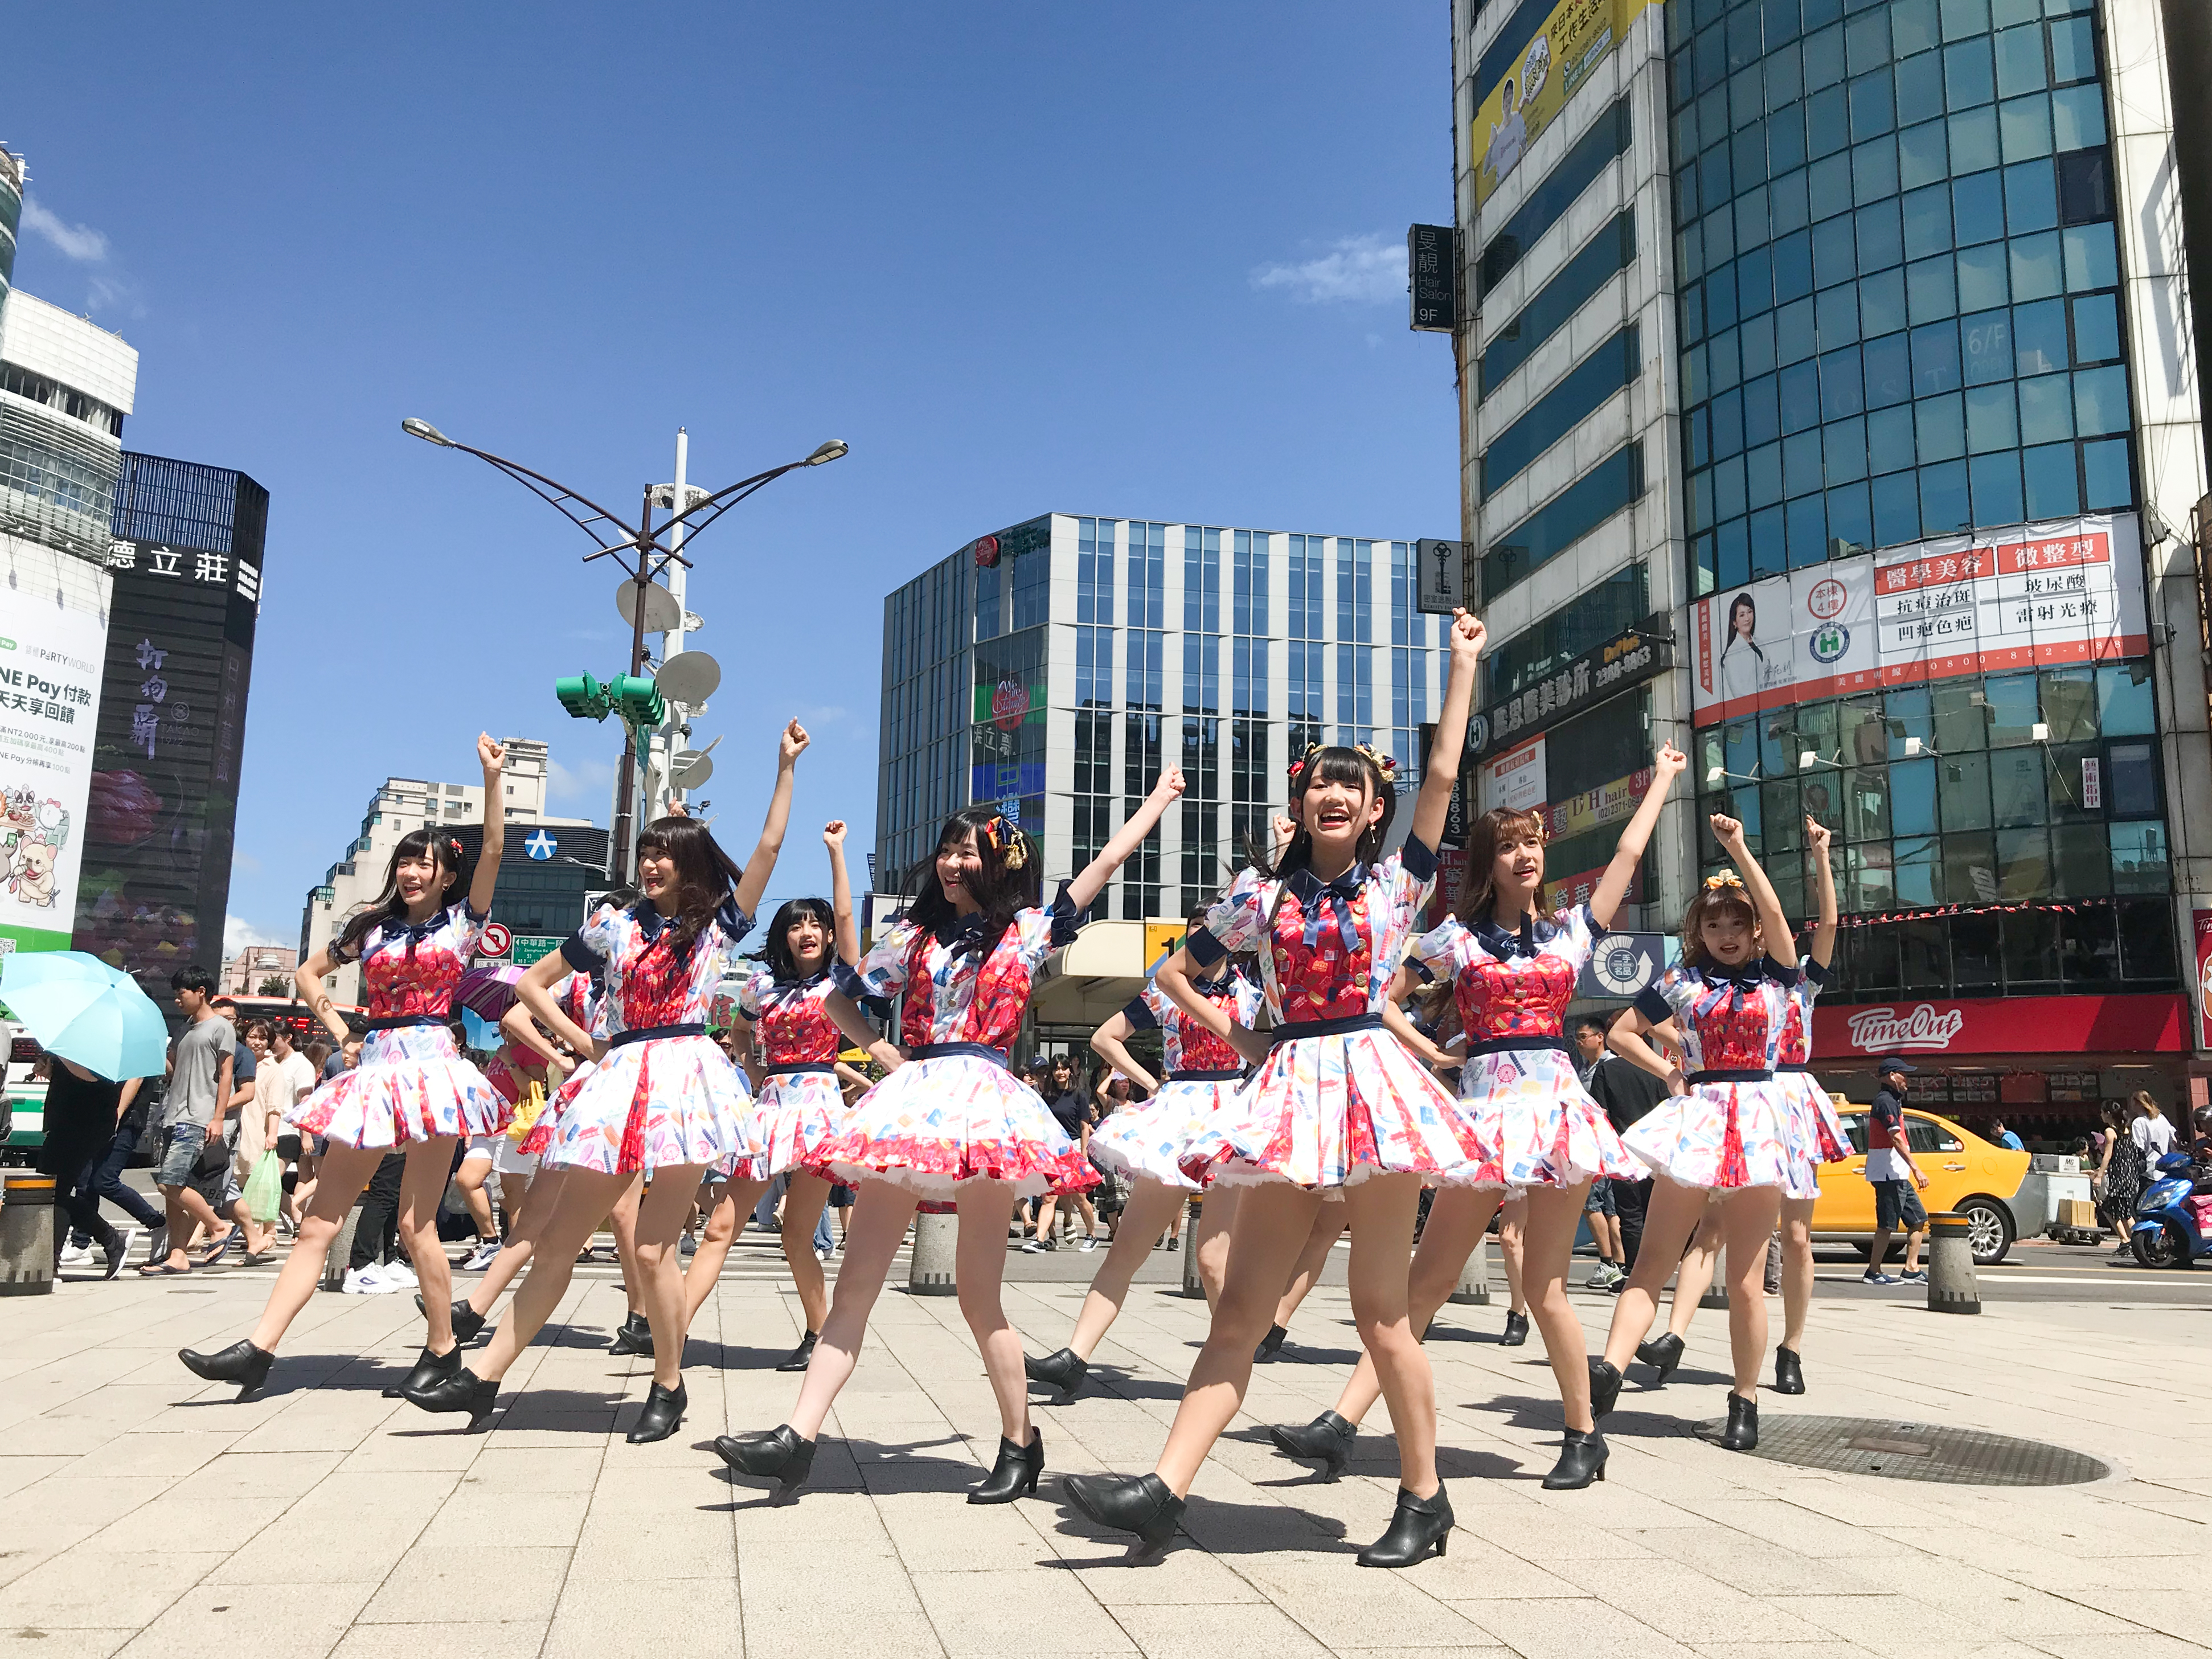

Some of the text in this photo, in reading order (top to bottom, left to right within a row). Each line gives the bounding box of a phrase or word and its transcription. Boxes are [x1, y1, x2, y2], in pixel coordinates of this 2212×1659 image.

[1418, 275, 1441, 288] Hair
[1419, 287, 1452, 301] Salon
[1419, 308, 1438, 322] 9F
[1968, 323, 2008, 355] 6/F
[107, 539, 229, 582] 德立莊
[2014, 538, 2095, 568] 微整型
[1886, 554, 1983, 589] 醫學美容
[2025, 574, 2085, 593] 玻尿酸
[1896, 588, 1971, 615] 抗痘治斑
[2016, 599, 2098, 623] 雷射光療
[1898, 615, 1973, 642] 凹疤色疤
[1, 639, 14, 649] Pay
[27, 674, 62, 700] Pay
[63, 683, 92, 707] 付款
[161, 723, 199, 736] TAKAO
[1604, 787, 1628, 805] hair
[1635, 768, 1649, 789] 3F
[521, 939, 564, 948] 中華路一段
[1161, 937, 1175, 959] 1
[1613, 954, 1631, 963] 二手
[1614, 966, 1632, 976] 名品
[1849, 1004, 1963, 1048] TimeOut
